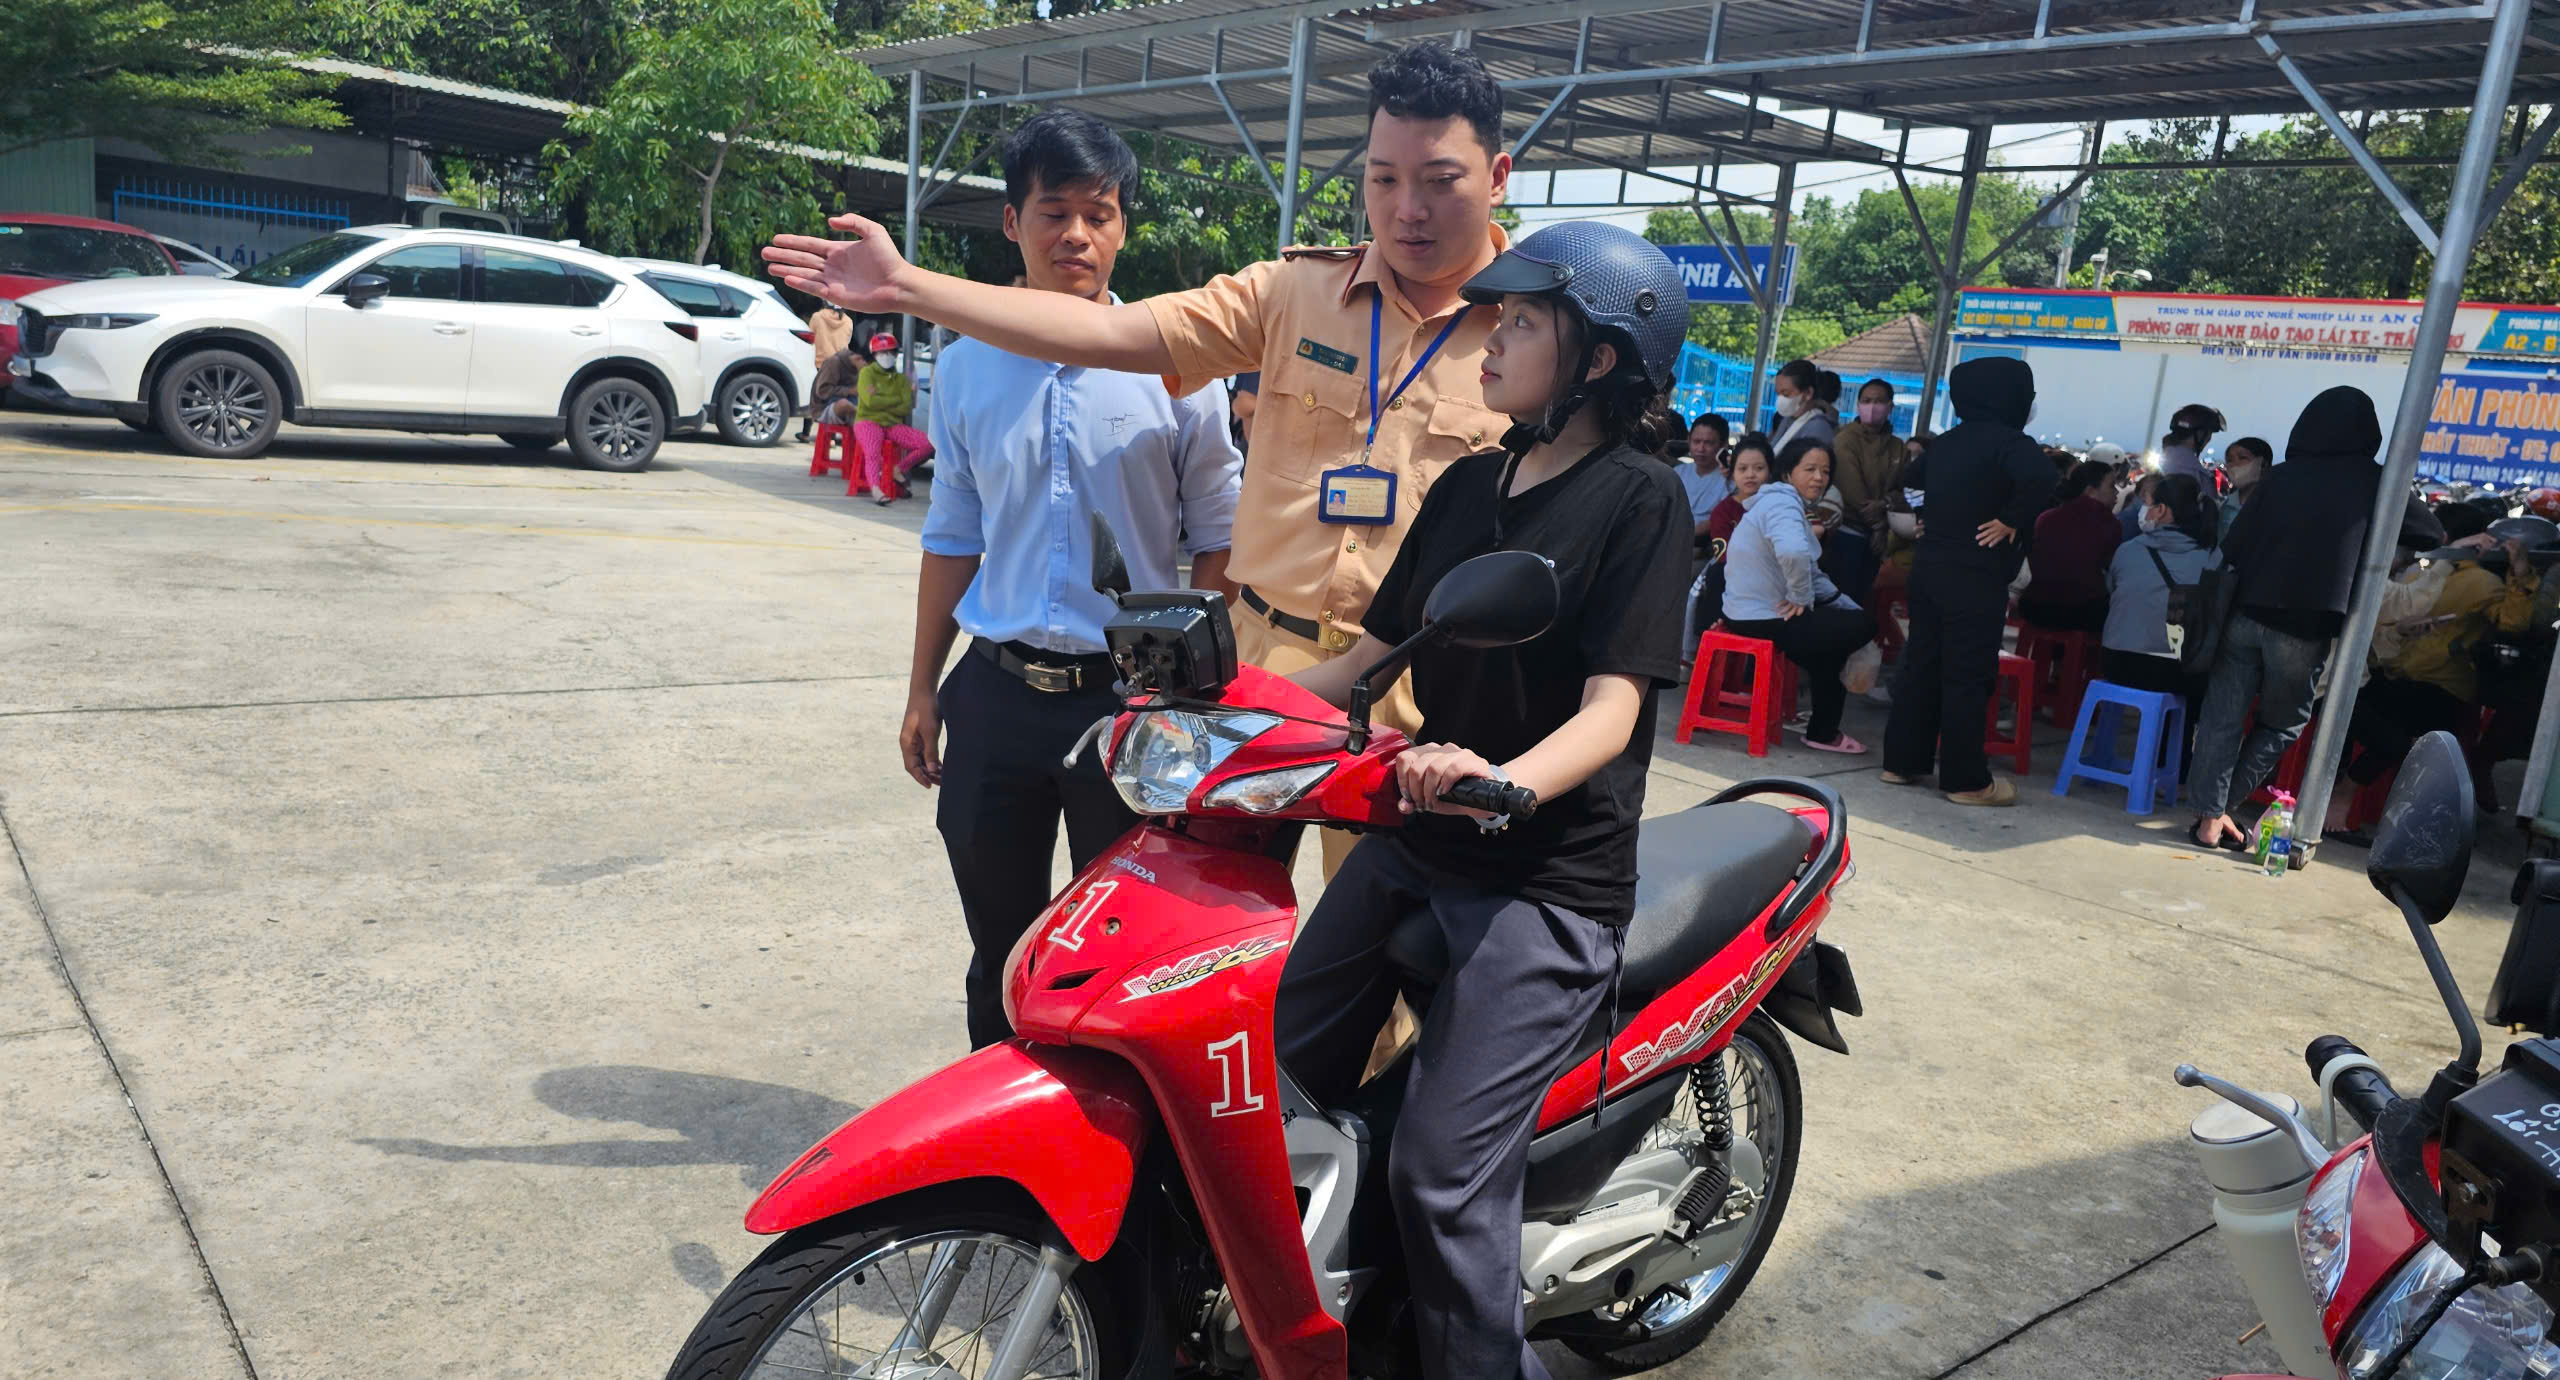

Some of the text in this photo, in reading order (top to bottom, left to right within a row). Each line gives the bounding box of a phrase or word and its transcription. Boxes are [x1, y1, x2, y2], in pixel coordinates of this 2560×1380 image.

[1677, 256, 1722, 288] ÌNH
[2158, 306, 2189, 316] TRUNG
[2194, 306, 2214, 317] TÂM
[2338, 311, 2355, 323] LÁI
[2360, 314, 2374, 323] XE
[2380, 313, 2406, 324] AN
[2127, 317, 2171, 336] PHÒNG
[2175, 322, 2200, 337] GHI
[2204, 323, 2247, 339] DANH
[2318, 325, 2346, 344] LÁI
[2350, 329, 2371, 345] XE
[2504, 332, 2529, 351] A2
[1110, 855, 1157, 884] HONDA
[1047, 879, 1120, 952] 1
[1148, 963, 1216, 993] WAVE
[1206, 1030, 1265, 1118] 1
